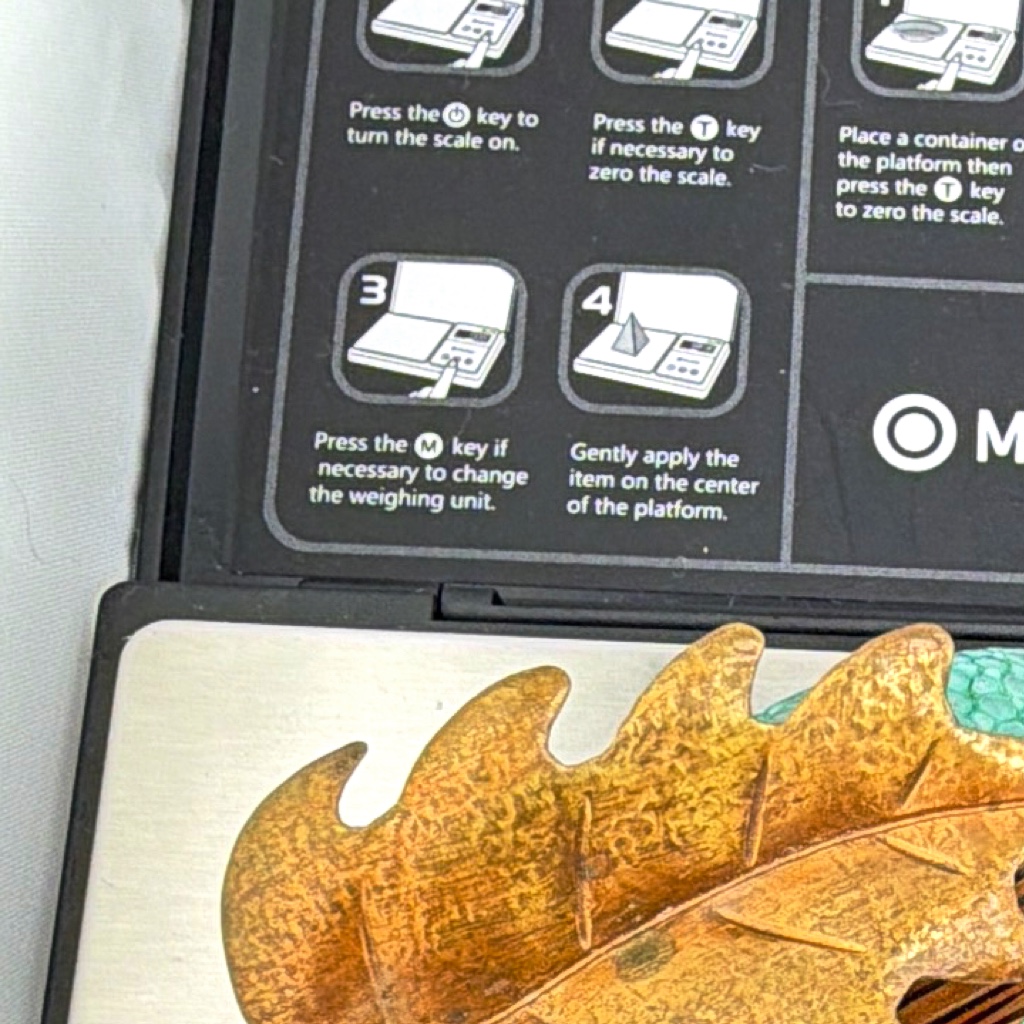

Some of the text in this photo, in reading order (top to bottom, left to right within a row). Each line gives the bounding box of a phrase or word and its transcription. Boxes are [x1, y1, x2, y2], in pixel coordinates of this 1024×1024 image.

[349, 101, 539, 128] Press the key to
[592, 114, 646, 133] Press
[651, 116, 683, 136] the
[726, 119, 761, 141] key
[347, 128, 521, 152] turn the scale on.
[591, 138, 735, 163] if necessary to
[839, 126, 892, 145] Place
[897, 133, 910, 146] a
[914, 131, 1008, 152] container
[588, 165, 732, 187] zero the scale.
[837, 152, 1013, 176] the platform then
[836, 180, 889, 197] press
[894, 179, 928, 197] the
[970, 183, 1005, 204] key
[835, 202, 1005, 226] to zero the scale.
[359, 274, 388, 306] 3
[581, 285, 613, 316] 4
[314, 432, 368, 452] Press
[373, 434, 408, 453] the
[451, 436, 488, 459] key
[493, 438, 508, 457] if
[570, 443, 740, 470] Gently apply the
[317, 462, 529, 489] necessary to change
[568, 470, 760, 495] item on the center
[308, 485, 496, 513] the weighing unit.
[567, 498, 728, 522] of the platform.
